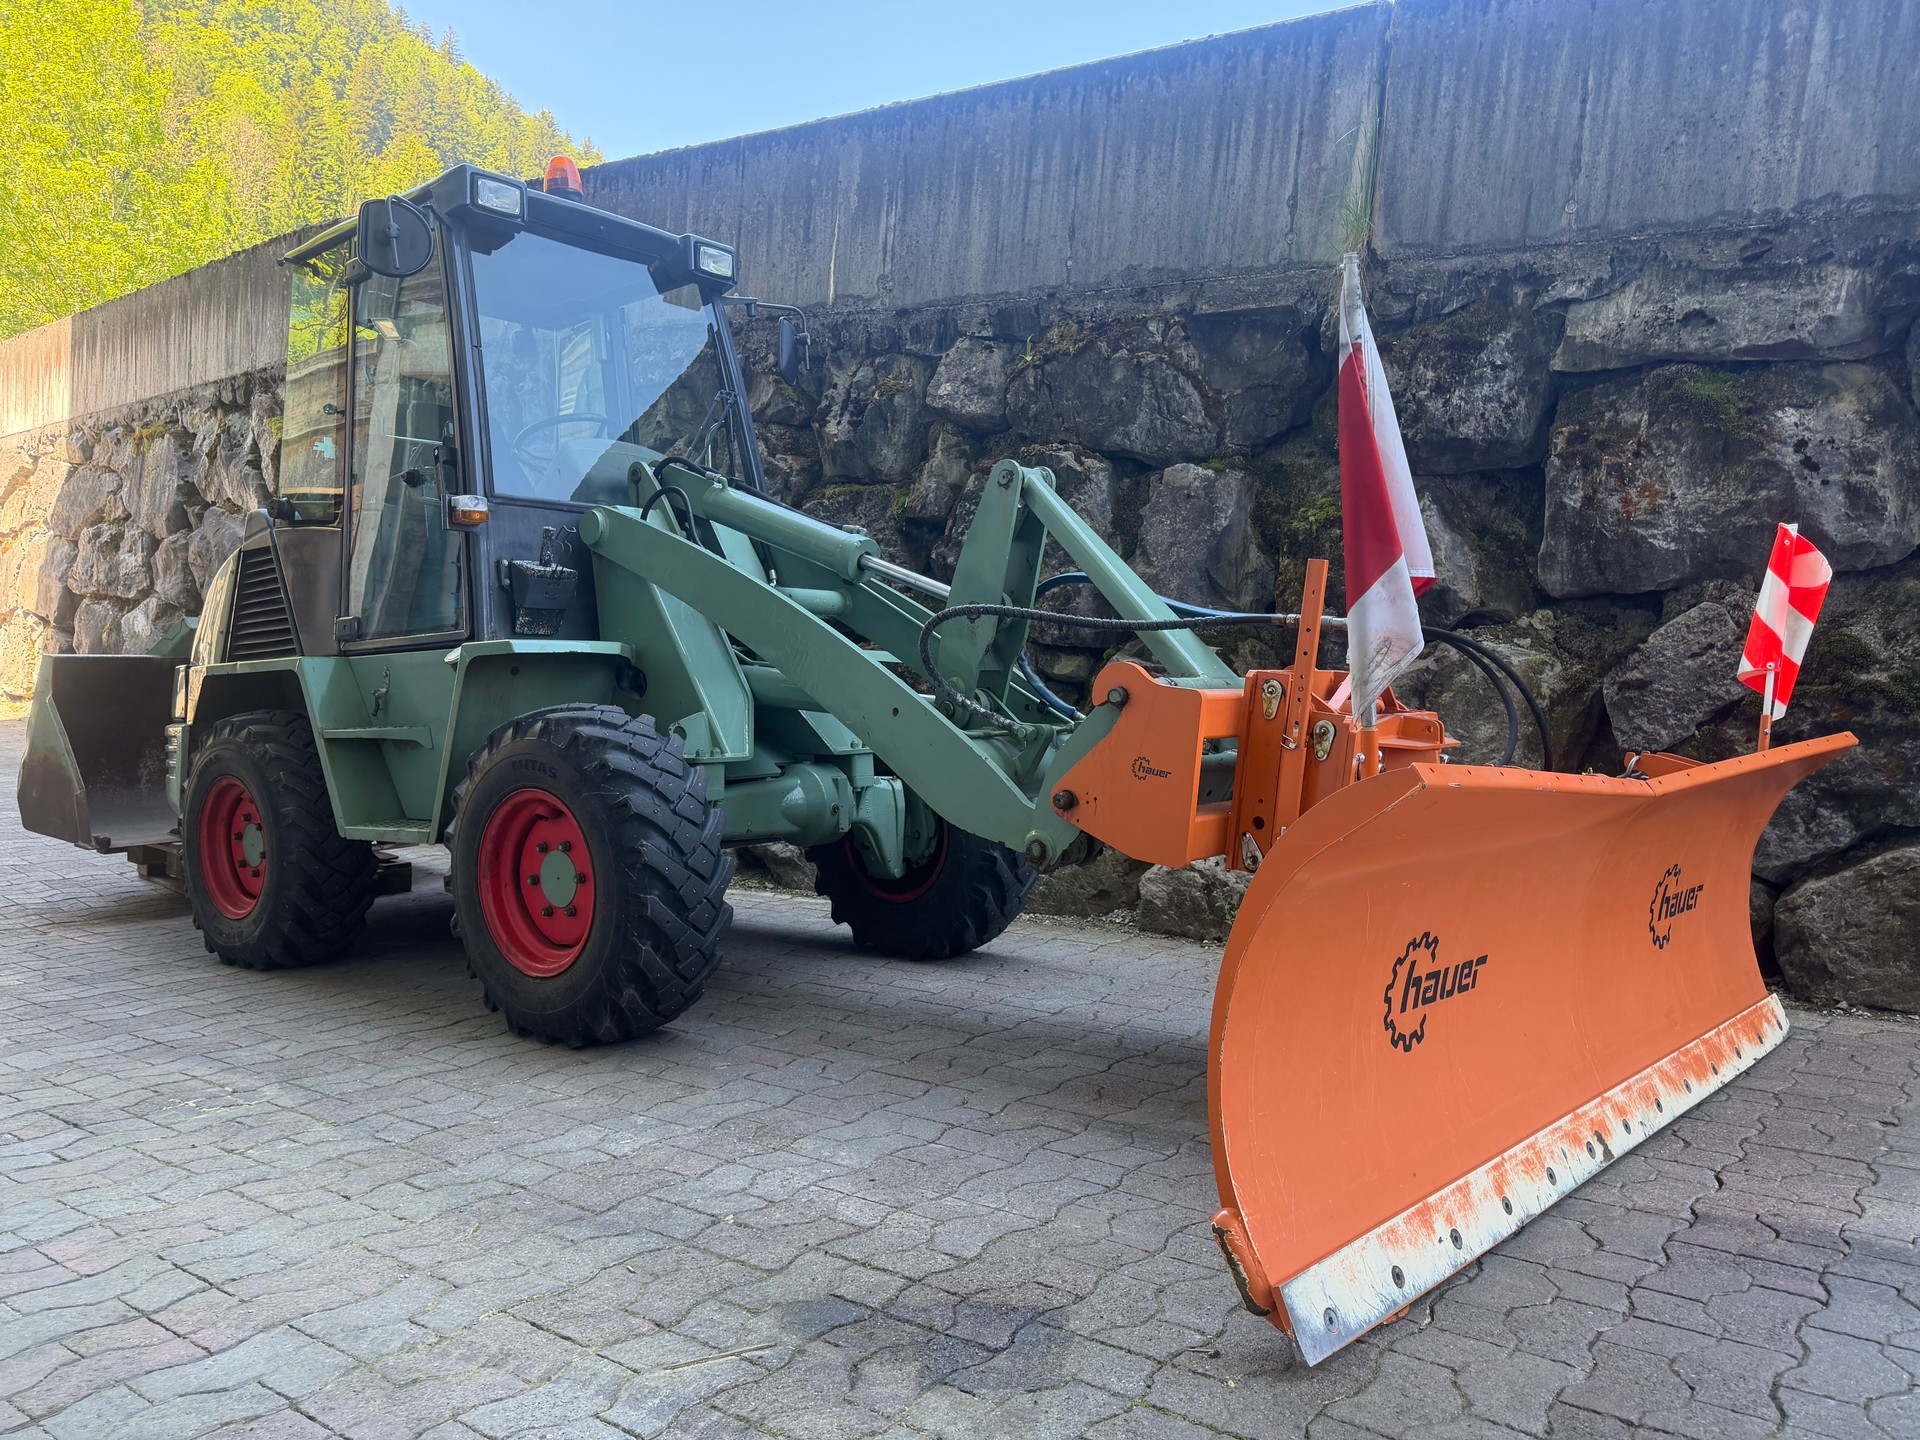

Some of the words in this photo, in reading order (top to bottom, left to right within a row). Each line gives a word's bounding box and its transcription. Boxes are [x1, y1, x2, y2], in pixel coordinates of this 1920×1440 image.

[1138, 761, 1172, 778] hauer
[1658, 884, 1704, 922] hauer
[1400, 954, 1489, 1014] hauer
